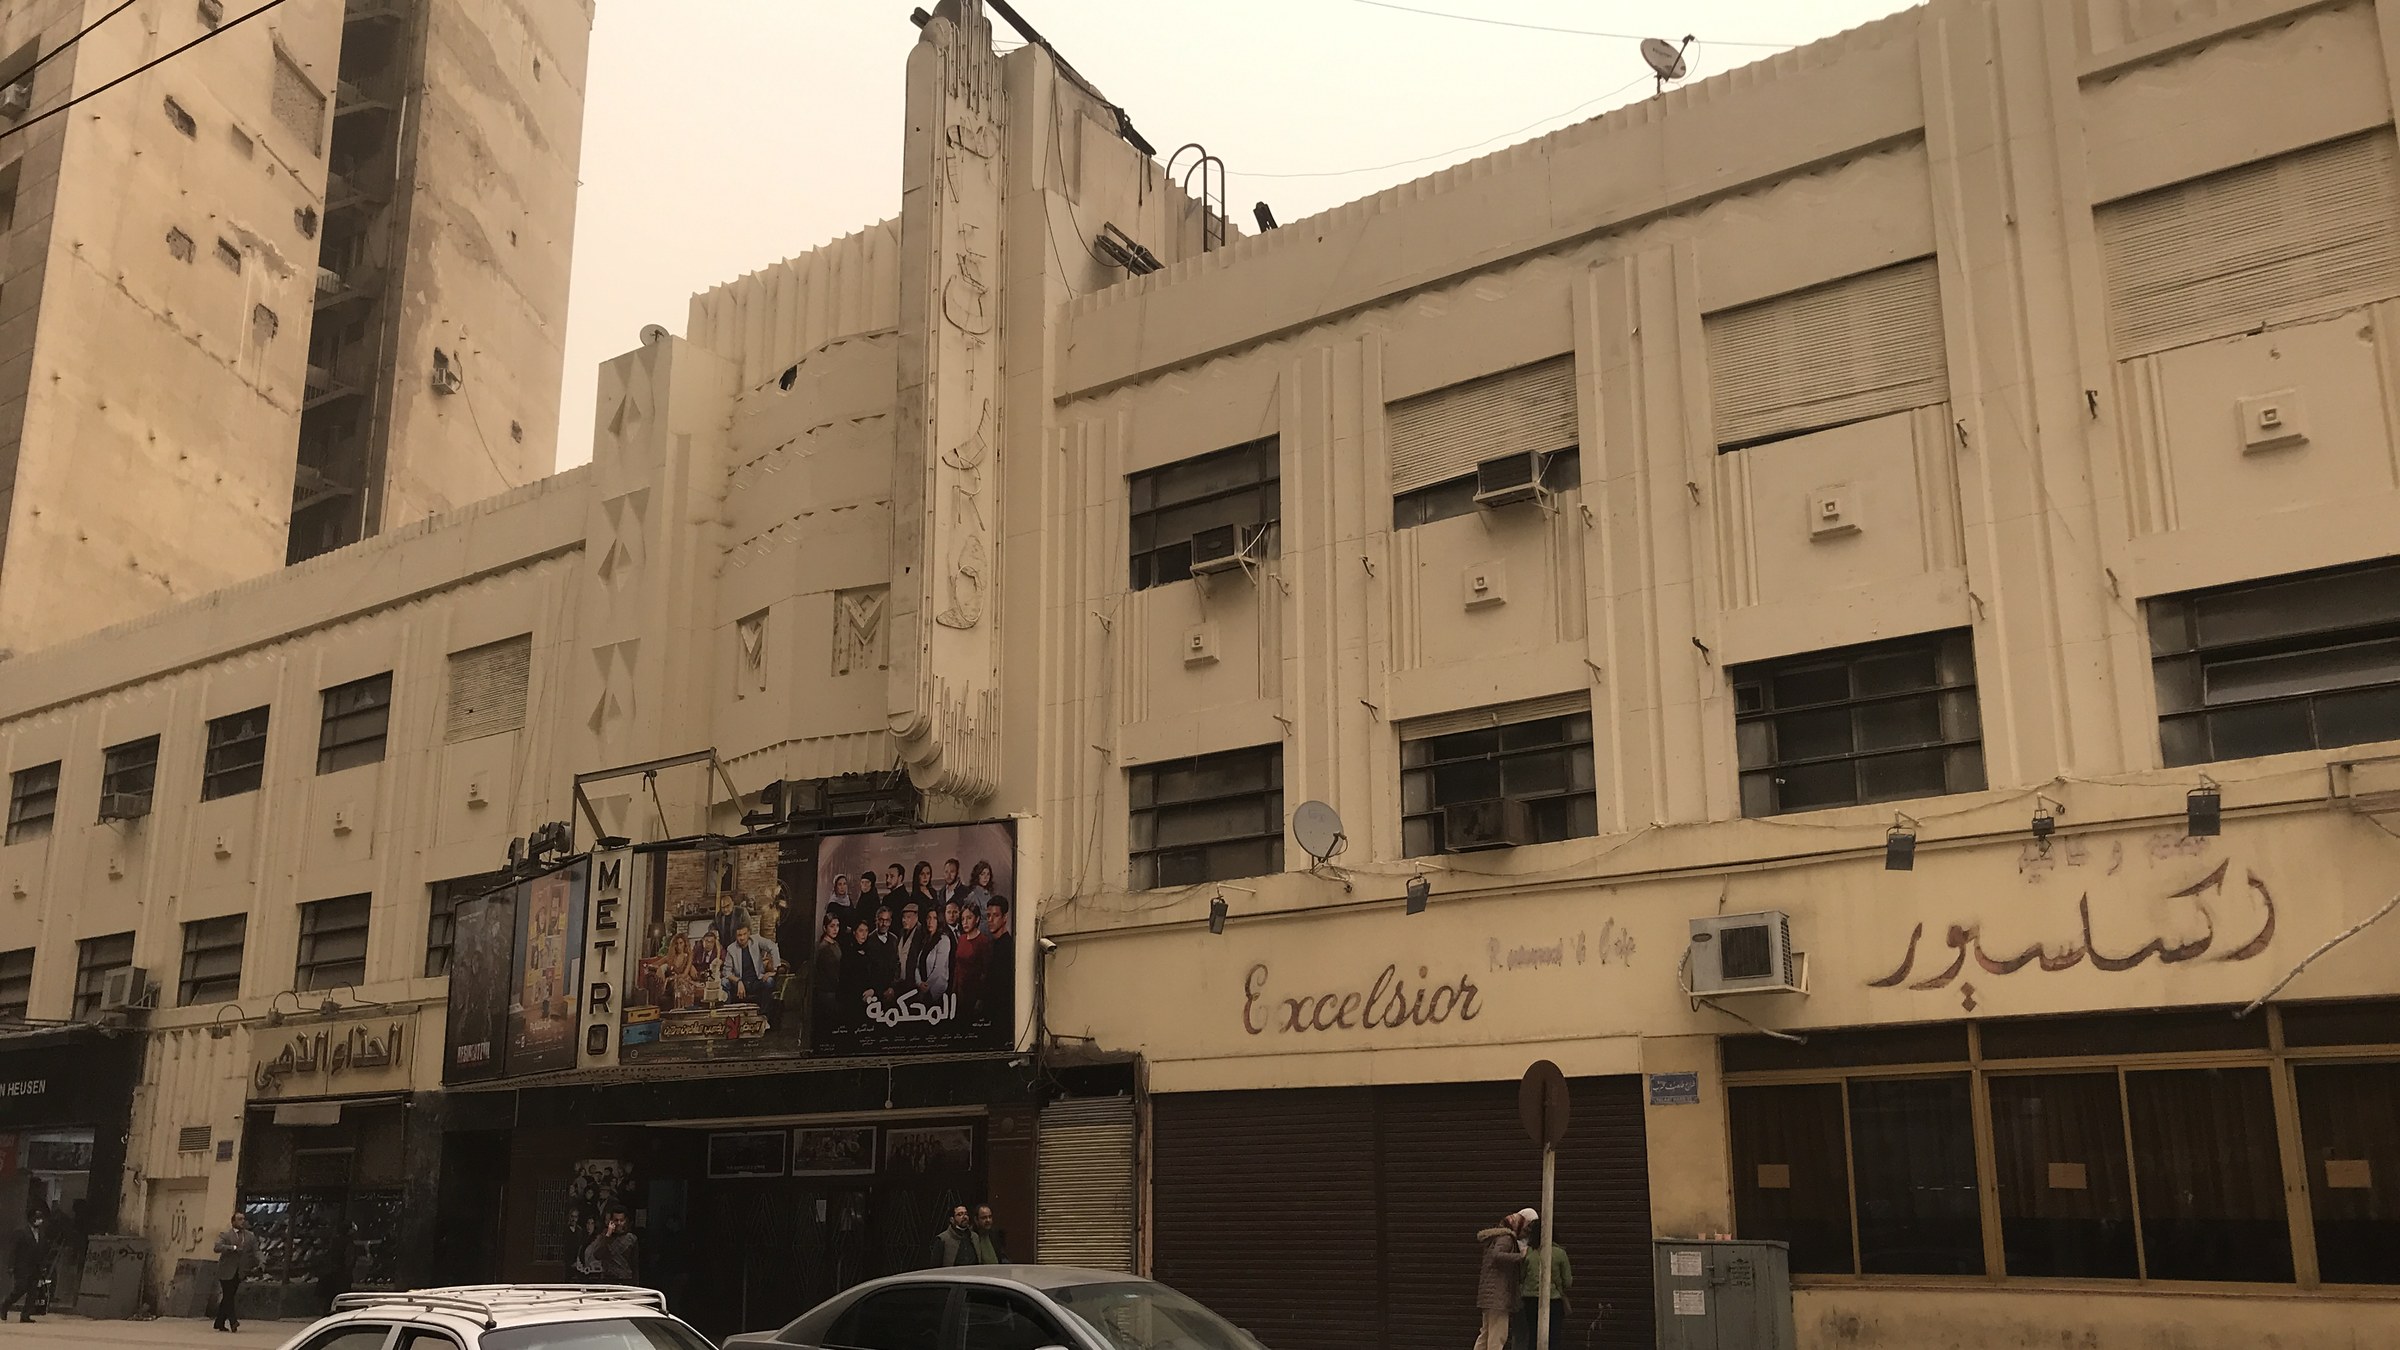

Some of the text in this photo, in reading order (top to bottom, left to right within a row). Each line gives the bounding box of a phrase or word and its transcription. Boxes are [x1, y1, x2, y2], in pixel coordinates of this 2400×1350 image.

[587, 859, 622, 1055] METRO
[864, 988, 958, 1028] المحكمة
[1243, 963, 1482, 1035] Excelsior
[7, 1079, 46, 1096] HEUSEN
